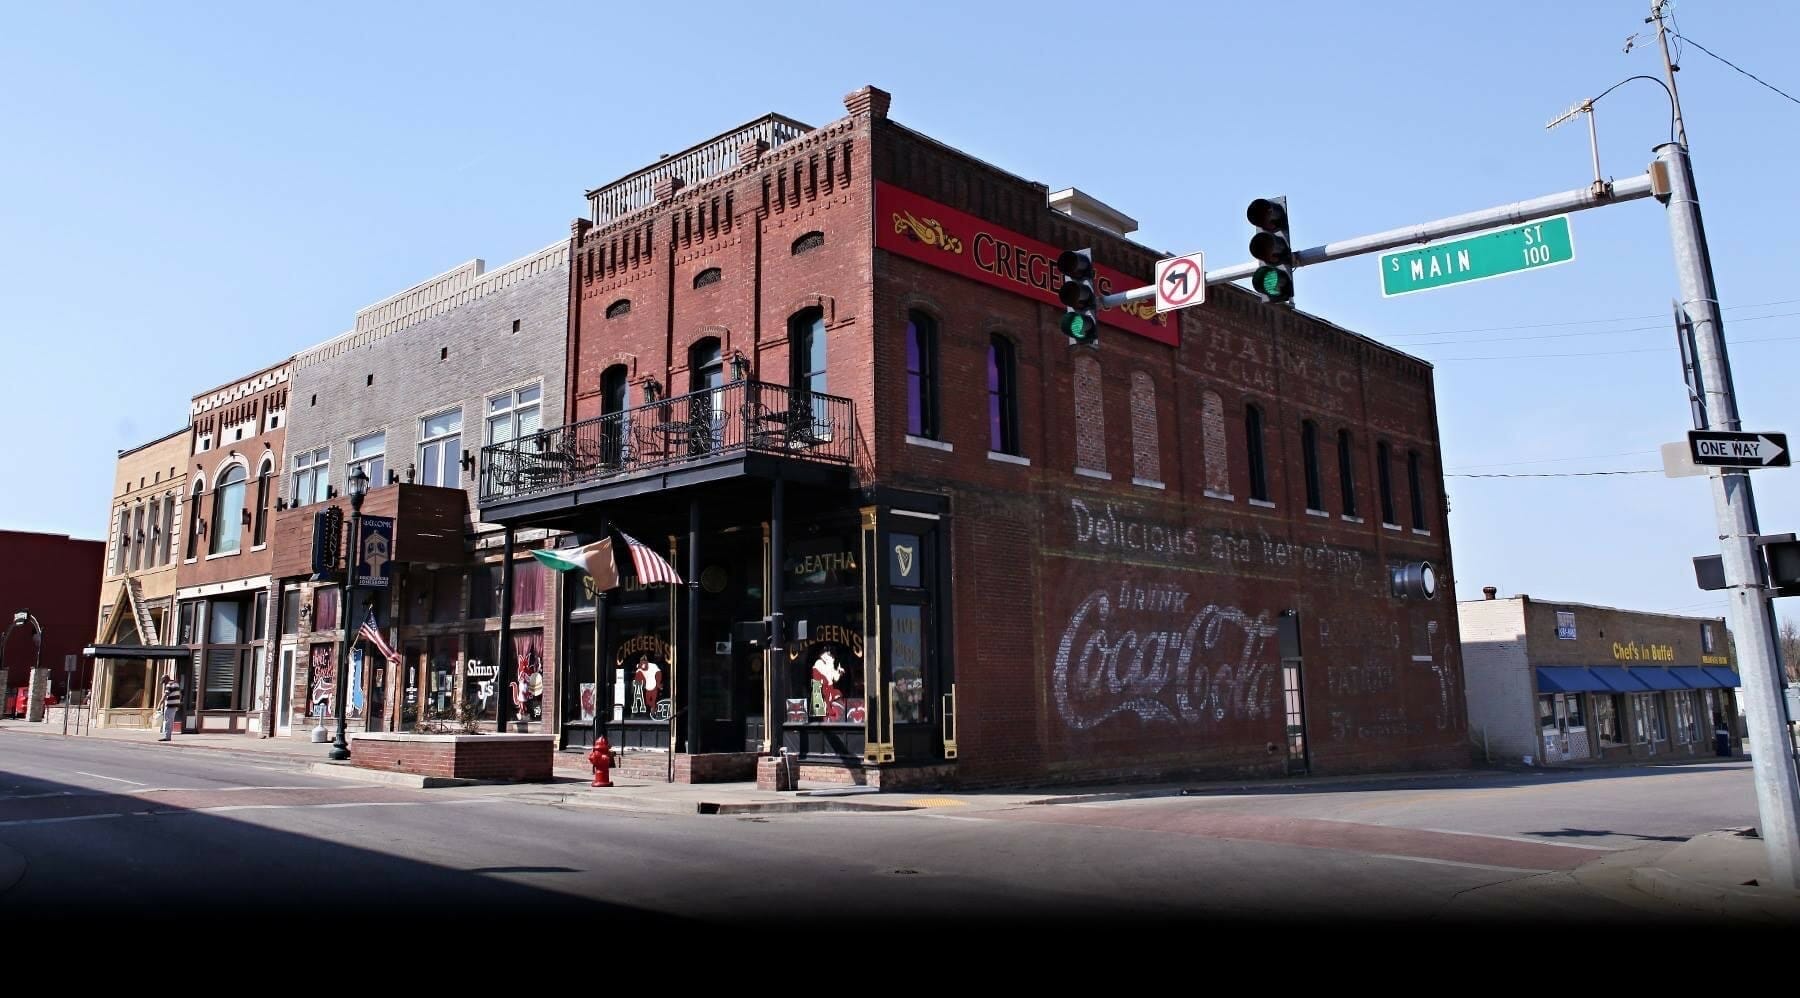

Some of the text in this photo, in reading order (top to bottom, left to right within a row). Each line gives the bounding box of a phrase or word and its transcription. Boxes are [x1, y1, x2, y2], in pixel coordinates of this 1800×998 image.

[1392, 225, 1543, 281] S MAIN ST
[1523, 244, 1550, 266] 100
[972, 232, 1114, 311] CREGE'S
[1700, 441, 1759, 456] ONE WAY
[1071, 499, 1198, 556] Delicious
[1117, 579, 1191, 613] DRINK
[616, 635, 672, 666] CREGEEN'S
[1613, 641, 1640, 661] Chef's
[1651, 644, 1674, 662] Buffet
[467, 659, 500, 684] Skinny
